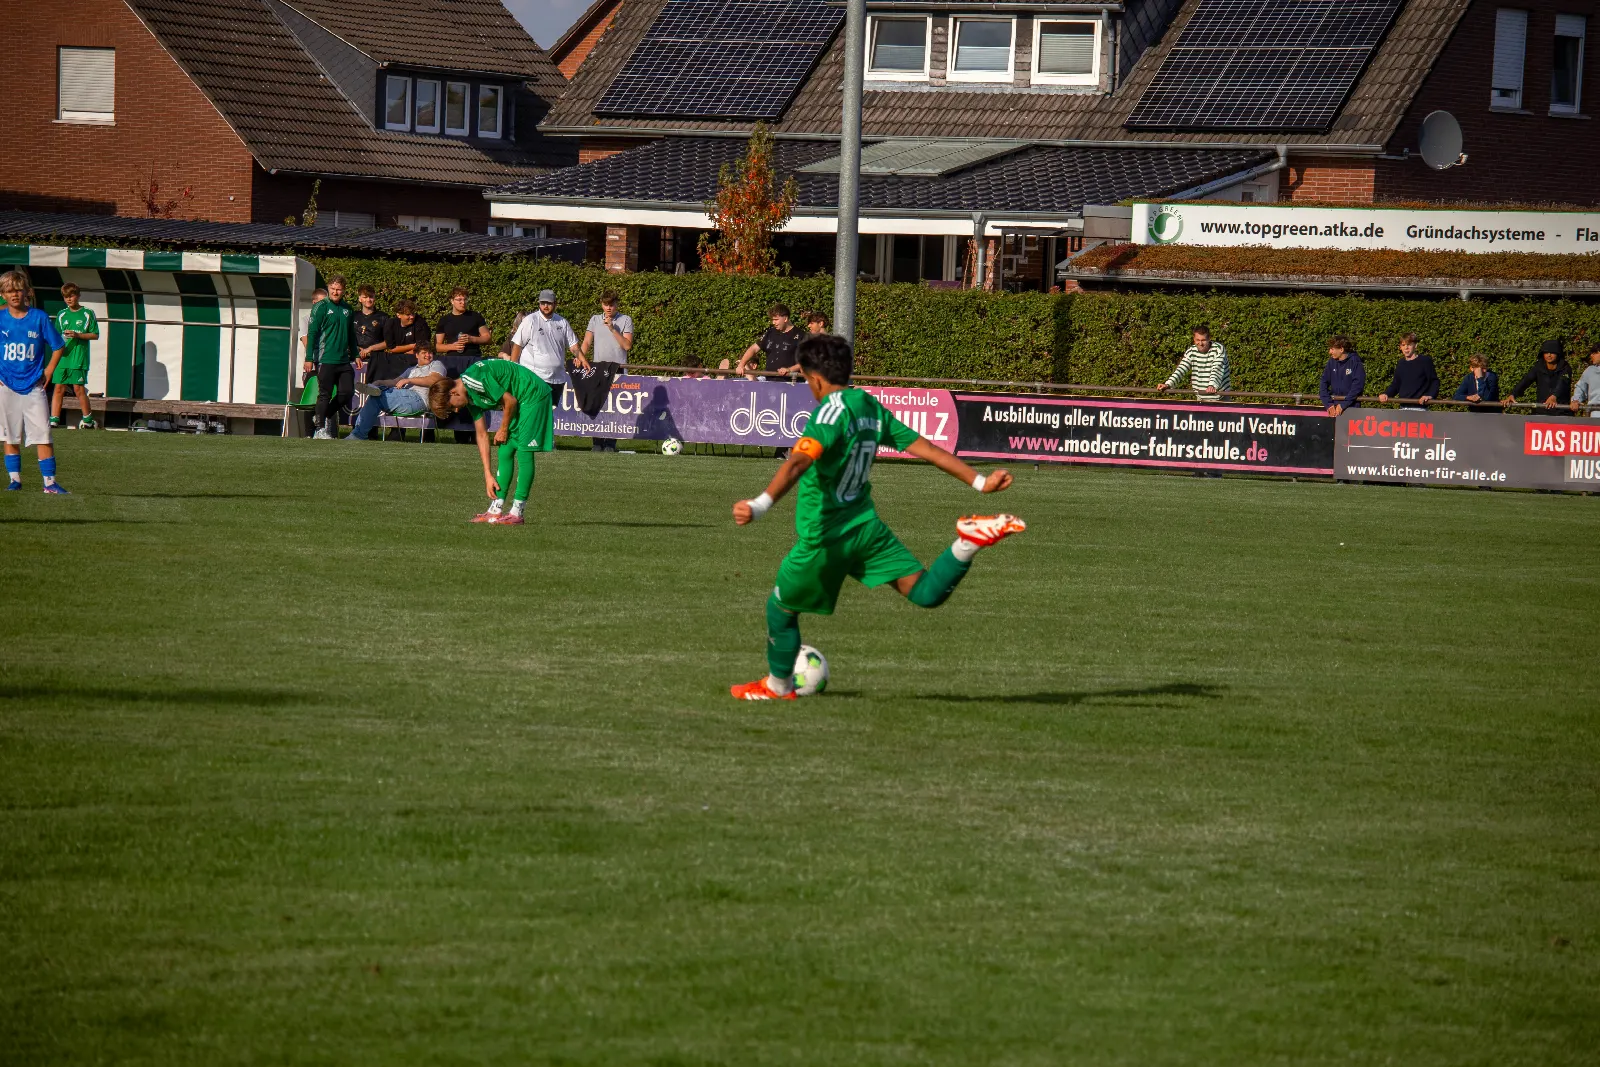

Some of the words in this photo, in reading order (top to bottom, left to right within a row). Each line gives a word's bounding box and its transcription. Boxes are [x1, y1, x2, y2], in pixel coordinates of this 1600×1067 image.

[1148, 205, 1182, 229] TOPGREEN
[1200, 221, 1384, 239] www.topgreen.atka.de
[1406, 224, 1546, 243] Gründachsysteme
[4, 343, 35, 361] 1894
[621, 382, 641, 390] GmbH
[865, 389, 939, 406] ahrschule
[983, 405, 1060, 429] Ausbildung
[1064, 408, 1096, 427] aller
[1099, 410, 1151, 429] Klassen
[1155, 414, 1169, 430] in
[1173, 414, 1214, 432] Lohne
[1218, 416, 1245, 433] und
[1248, 417, 1296, 436] Vechta
[1348, 415, 1434, 439] KÜCHEN
[799, 439, 812, 451] C
[1008, 433, 1268, 462] www.moderne-fahrschule.de
[1531, 429, 1566, 452] DAS
[1392, 442, 1420, 460] für
[1424, 443, 1457, 461] alle
[1347, 465, 1507, 482] www.küchen-für-alle.de
